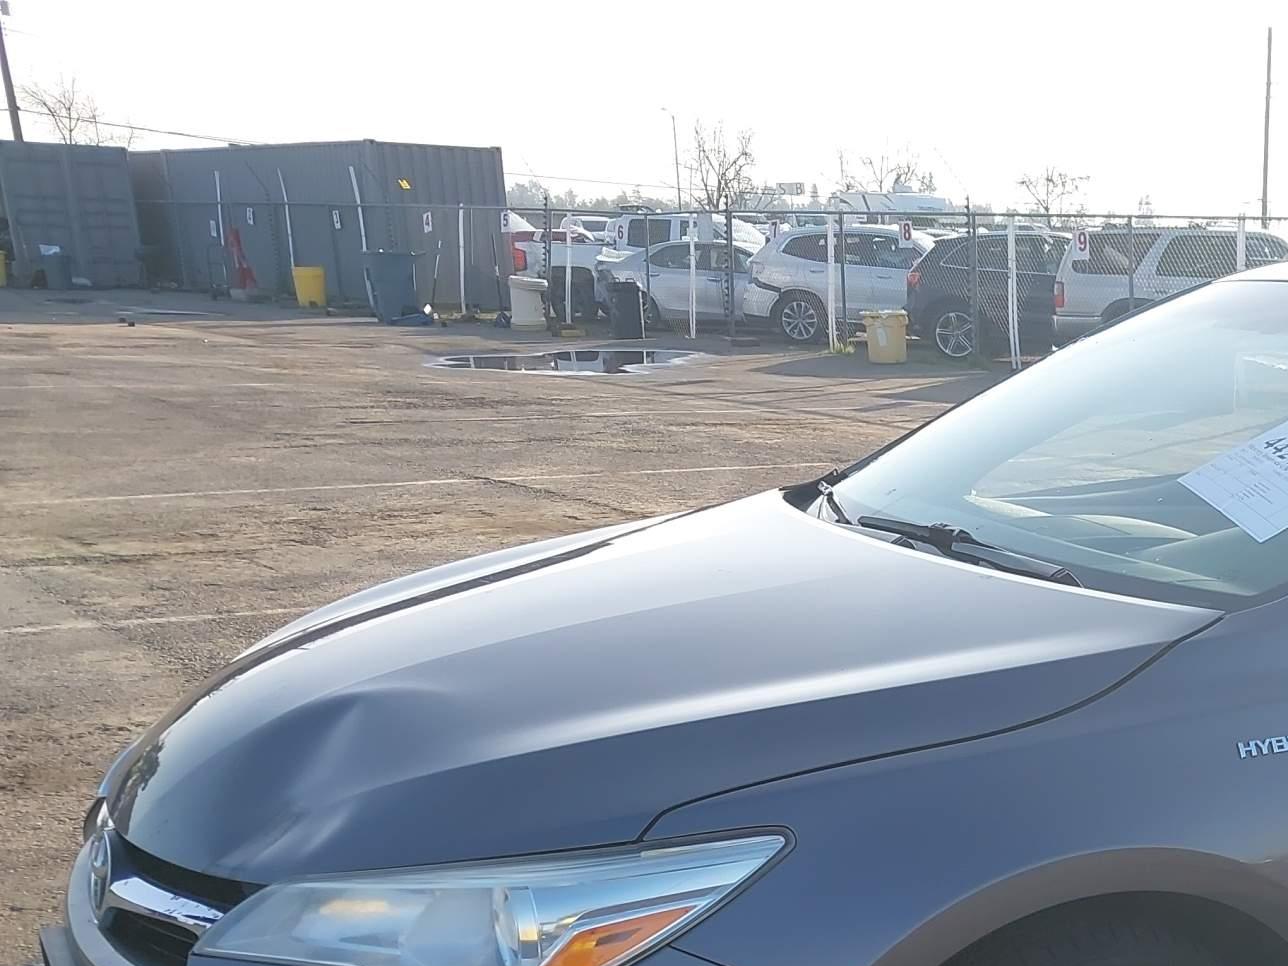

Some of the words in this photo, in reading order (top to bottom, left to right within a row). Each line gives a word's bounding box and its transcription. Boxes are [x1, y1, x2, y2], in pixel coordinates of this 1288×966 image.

[425, 213, 431, 227] 4
[503, 213, 508, 227] 5
[617, 225, 624, 240] 6
[771, 222, 778, 238] 7
[902, 222, 911, 241] 8
[1077, 231, 1087, 252] 9
